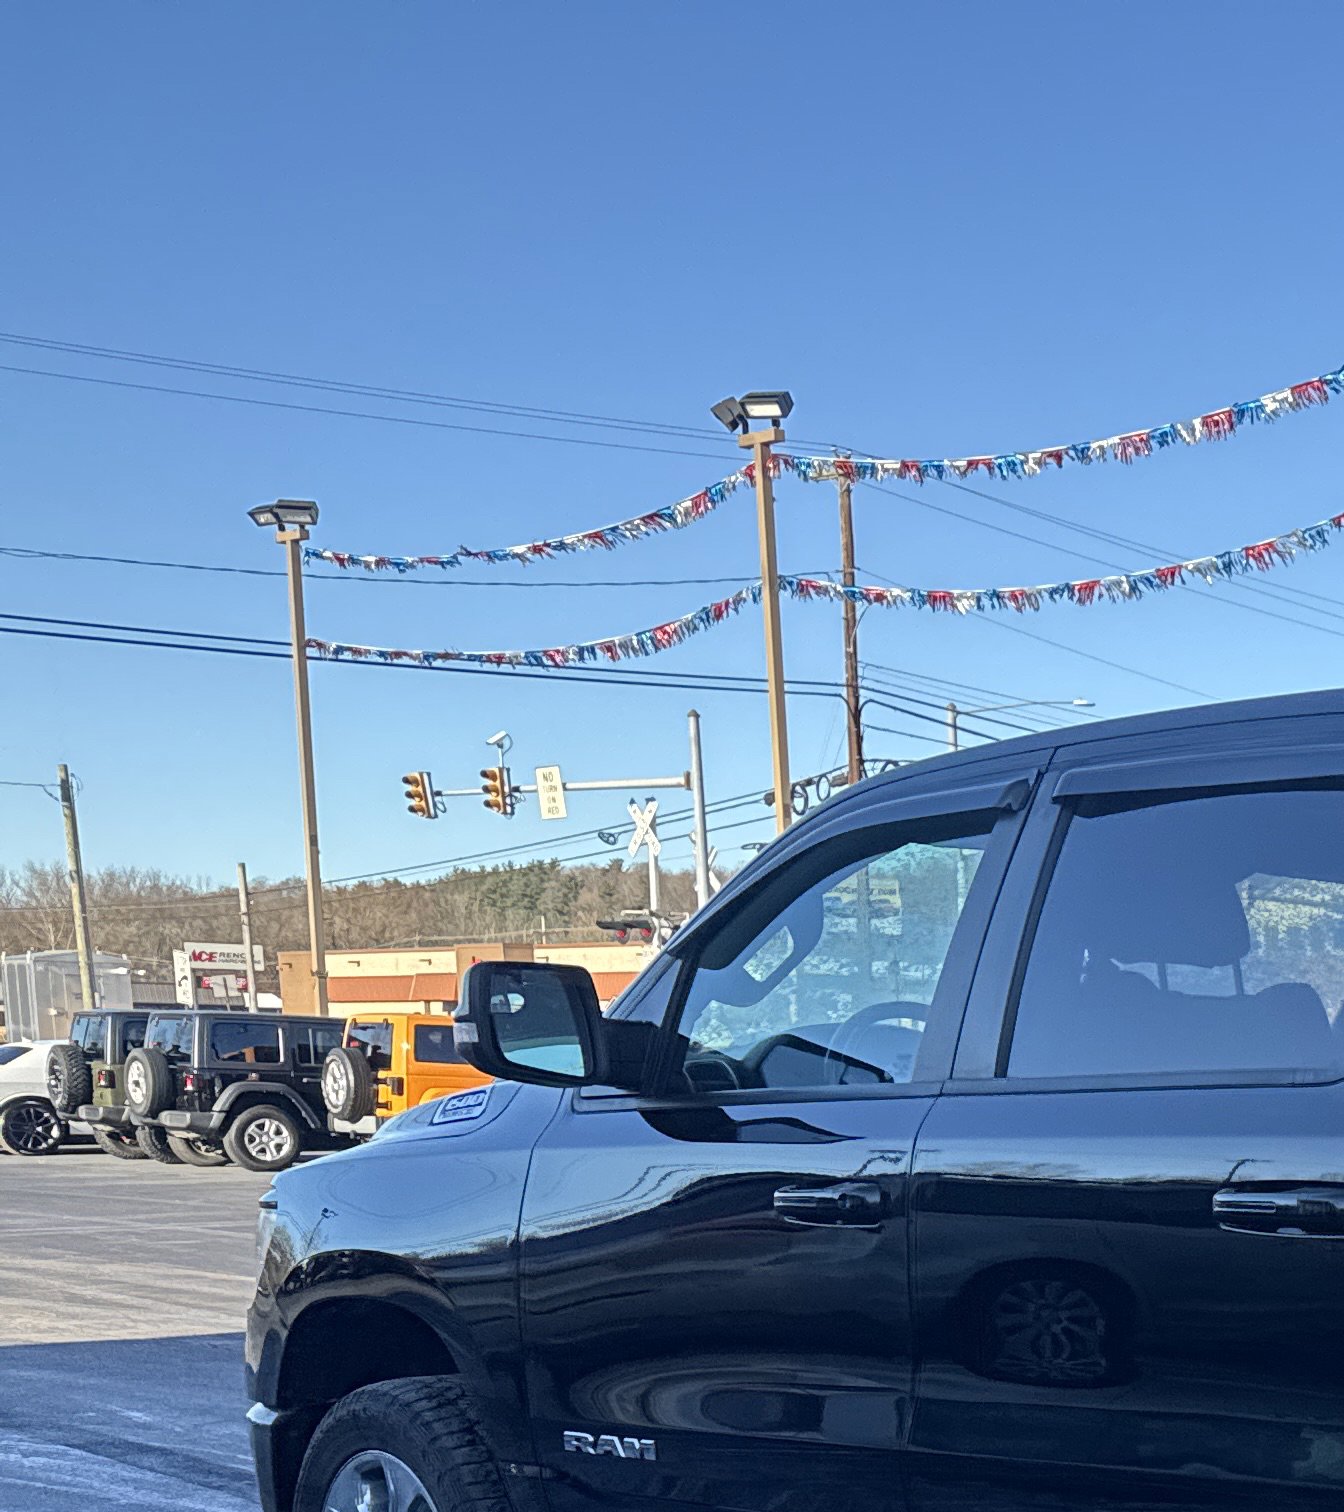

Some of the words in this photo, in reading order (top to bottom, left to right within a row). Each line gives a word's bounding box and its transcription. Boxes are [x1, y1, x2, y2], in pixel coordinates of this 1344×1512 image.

[542, 771, 554, 783] NO
[542, 784, 558, 793] TURN
[546, 795, 557, 804] ON
[547, 806, 560, 815] RED
[563, 1430, 657, 1461] RAM
